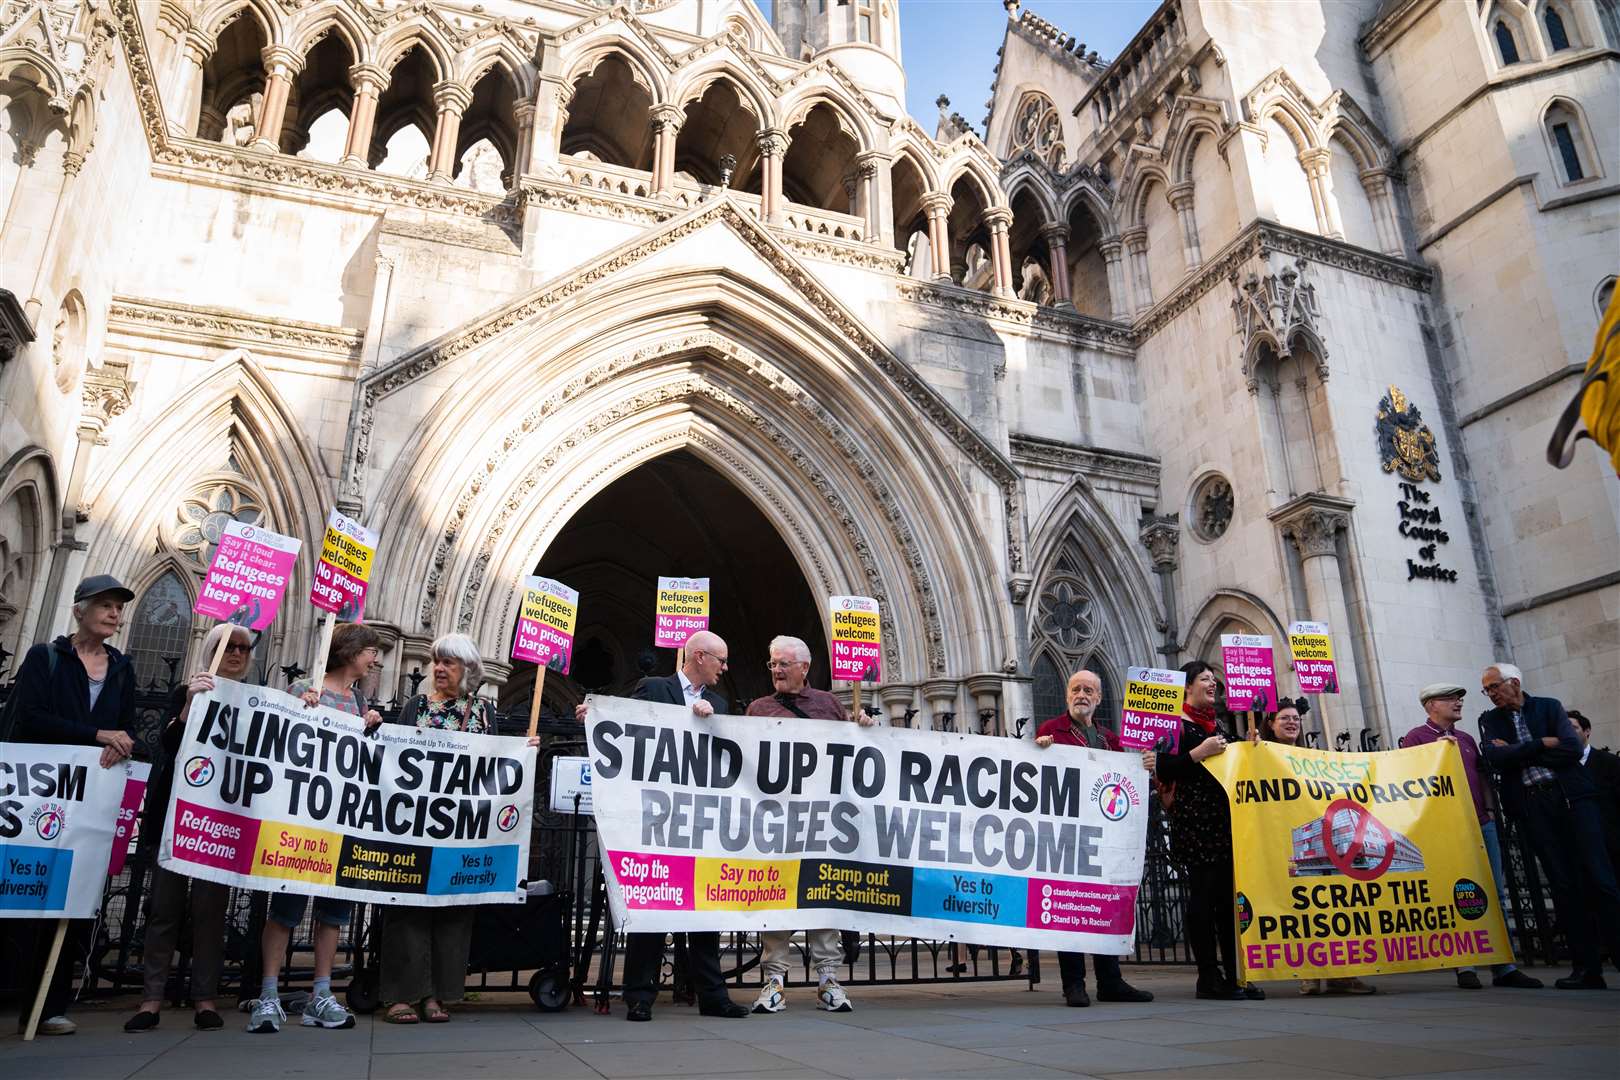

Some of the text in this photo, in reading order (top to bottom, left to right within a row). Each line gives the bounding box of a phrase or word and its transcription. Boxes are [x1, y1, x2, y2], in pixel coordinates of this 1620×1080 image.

[1399, 482, 1430, 505] The
[1397, 501, 1442, 525] Royal
[1399, 520, 1450, 544] Courts
[224, 537, 274, 558] Say it loud
[326, 528, 367, 561] Refugees
[1418, 543, 1437, 562] of
[221, 545, 276, 569] Say it clear:
[322, 546, 362, 576] welcome
[215, 554, 284, 586] Refugees
[317, 561, 363, 597] No prison
[1407, 558, 1458, 583] Justice
[203, 583, 240, 605] here
[210, 571, 276, 600] welcome
[314, 577, 343, 603] barge
[528, 591, 572, 617] Refugees
[660, 604, 702, 614] welcome
[661, 592, 704, 604] Refugees
[526, 607, 568, 630] welcome
[659, 616, 705, 629] No prison
[834, 612, 876, 627] Refugees
[522, 621, 570, 649] No prison
[659, 628, 686, 641] barge
[836, 626, 875, 640] welcome
[1291, 636, 1327, 648] Refugees
[519, 635, 550, 656] barge
[835, 642, 878, 658] No prison
[1225, 648, 1237, 656] Say
[1245, 648, 1258, 656] loud
[1294, 648, 1328, 658] welcome
[835, 656, 863, 673] barge
[1225, 655, 1238, 664] Say
[1226, 663, 1272, 677] Refugees
[1296, 661, 1333, 674] No prison
[1129, 682, 1178, 699] Refugees
[1227, 675, 1271, 686] welcome
[1299, 673, 1323, 686] barge
[1228, 687, 1252, 698] here
[1128, 698, 1174, 712] welcome
[1125, 712, 1177, 730] No prison
[1123, 725, 1155, 742] barge
[196, 699, 523, 796] ISLINGTON STAND
[592, 720, 1081, 818] STAND UP TO RACISM
[1286, 755, 1371, 781] DORSET
[220, 756, 492, 840] UP TO RACISM
[1091, 772, 1139, 805] STAND UP TO RACISM
[1235, 775, 1455, 804] STAND UP TO RACISM
[179, 810, 241, 840] Refugees
[641, 789, 1103, 878] REFUGEES WELCOME
[175, 833, 236, 859] welcome
[279, 831, 328, 854] Say no to
[261, 849, 333, 878] Islamophobia
[351, 844, 416, 867] Stamp out
[461, 854, 493, 868] Yes to
[9, 858, 48, 876] Yes to
[341, 863, 422, 884] antisemitism
[620, 856, 670, 882] Stop the
[720, 863, 779, 885] Say no to
[818, 863, 889, 887] Stamp out
[0, 879, 48, 900] diversity
[450, 870, 497, 887] diversity
[953, 875, 993, 895] Yes to
[1455, 883, 1475, 891] STAND
[706, 883, 786, 906] Islamophobia
[806, 883, 901, 907] anti-Semitism
[1053, 887, 1120, 901] standuptoracism.org.uk
[1291, 879, 1431, 910] SCRAP THE
[943, 894, 1000, 920] diversity
[1053, 901, 1102, 914] @AntiRacismDay
[1051, 914, 1112, 927] 'Stand Up To Racism'
[1258, 911, 1373, 940] PRISON
[1378, 904, 1456, 934] BARGE!
[1383, 930, 1494, 962] WELCOME
